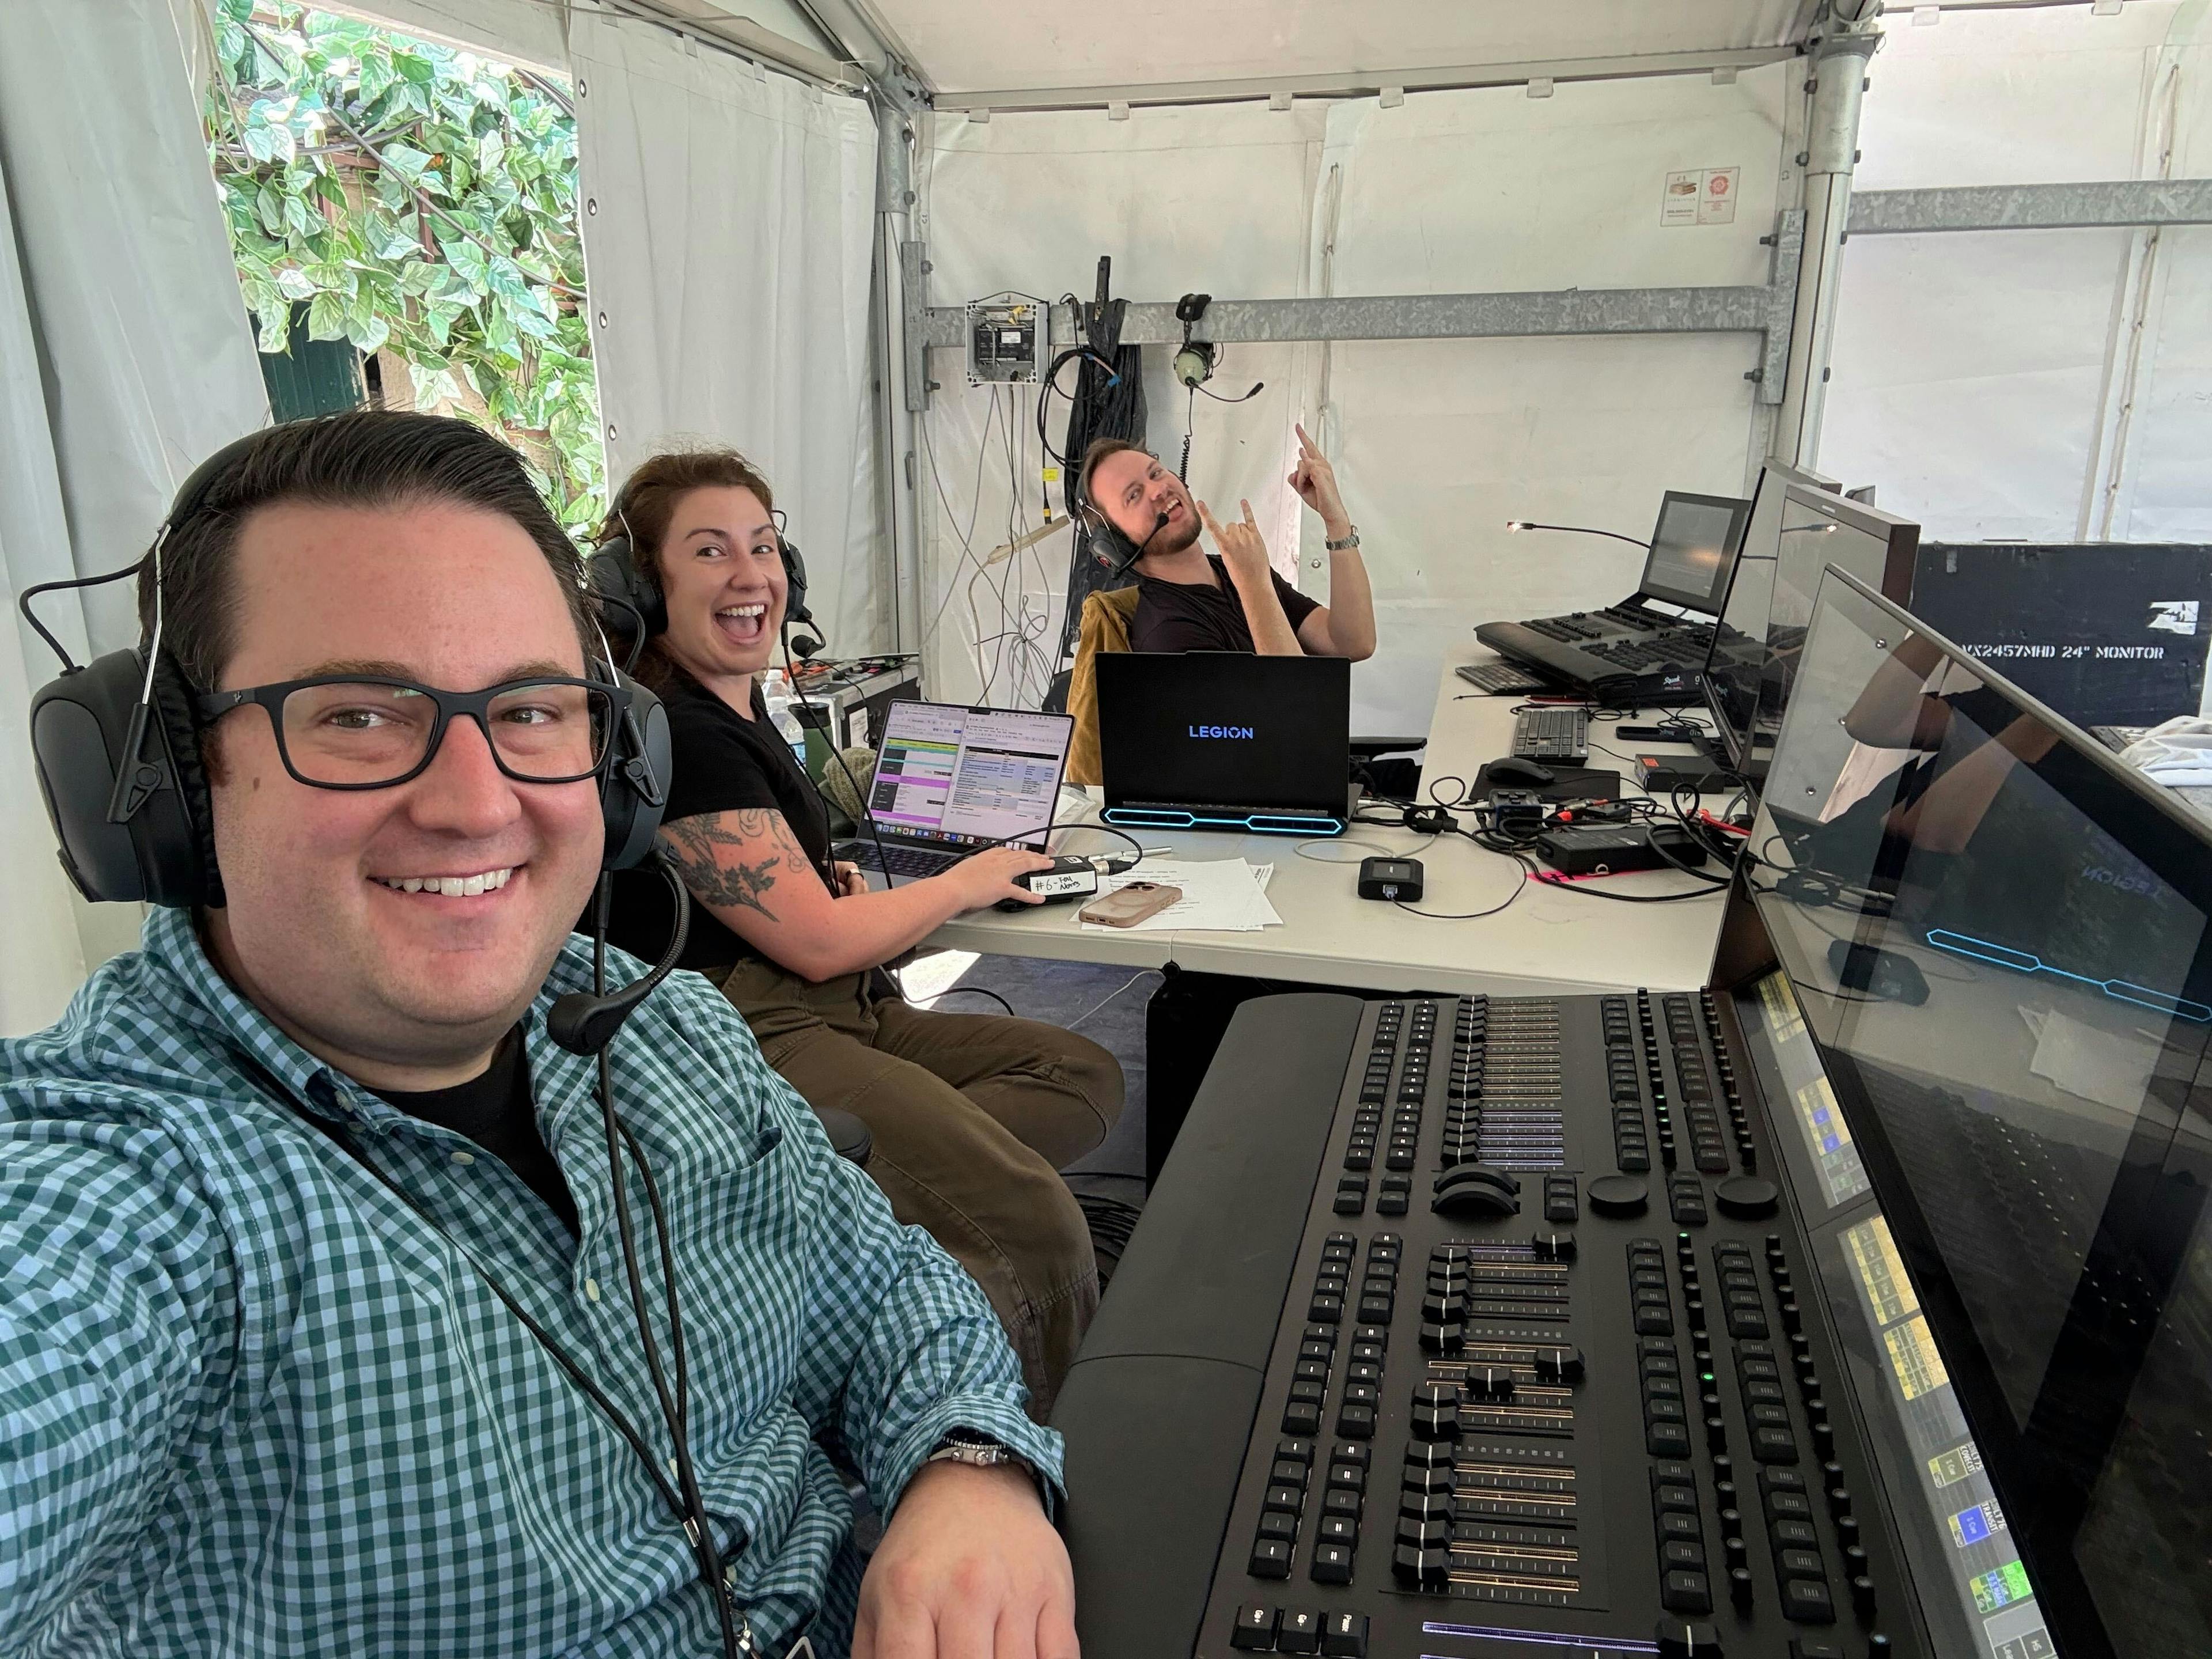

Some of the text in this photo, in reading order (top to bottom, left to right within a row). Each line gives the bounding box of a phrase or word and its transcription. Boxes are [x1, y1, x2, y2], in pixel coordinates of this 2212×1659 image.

[2062, 646, 2090, 658] 24"
[2096, 646, 2164, 659] MONITOR
[1189, 725, 1253, 739] LEGION
